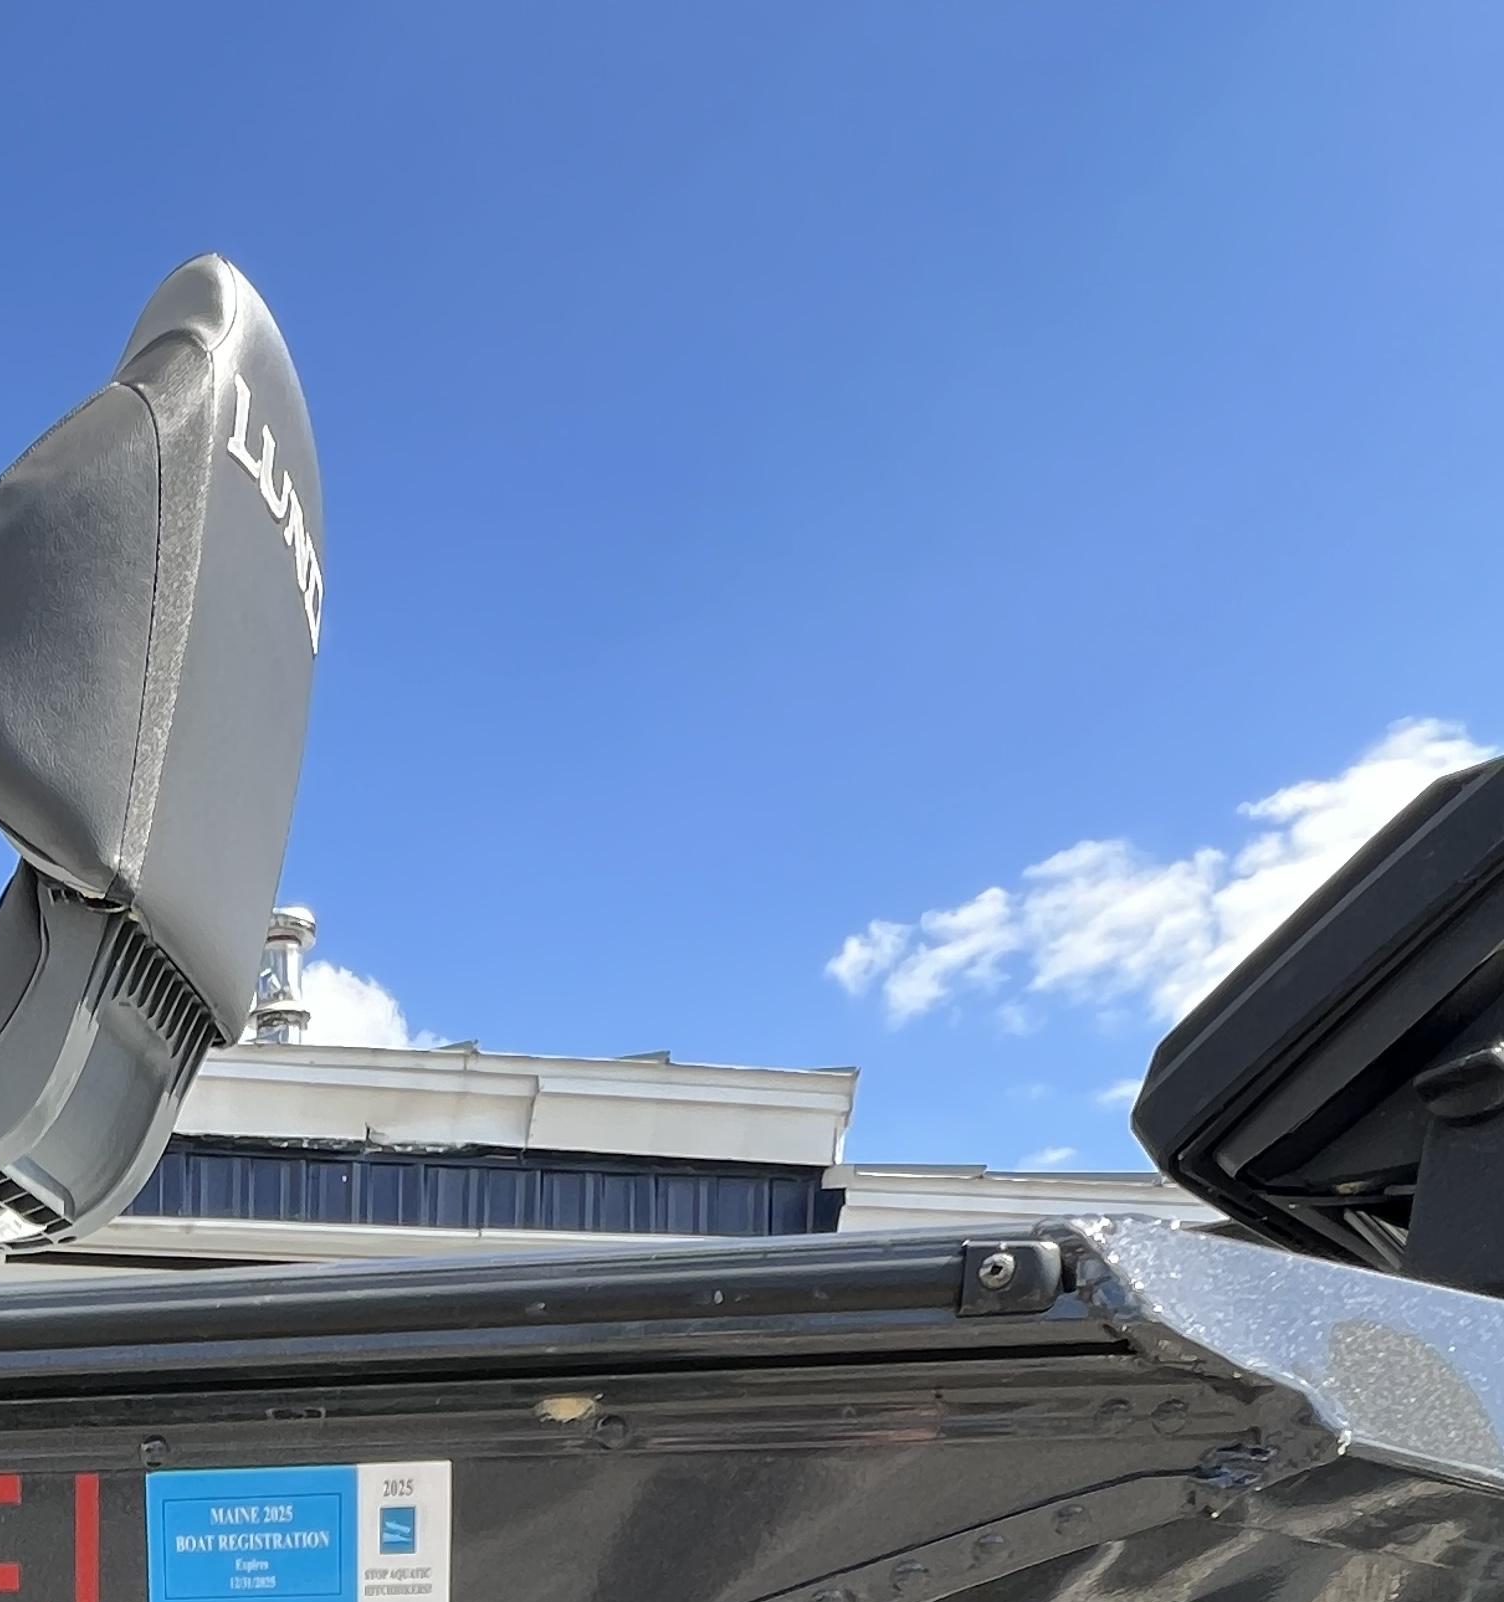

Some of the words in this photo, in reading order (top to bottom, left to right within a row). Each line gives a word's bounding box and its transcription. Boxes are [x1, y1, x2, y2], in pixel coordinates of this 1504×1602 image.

[227, 373, 325, 656] LUND
[382, 1478, 415, 1498] 2025
[210, 1507, 260, 1525] MAINE
[263, 1505, 294, 1523] 2025
[176, 1534, 215, 1552] BOAT
[218, 1530, 330, 1551] REGISTRATION
